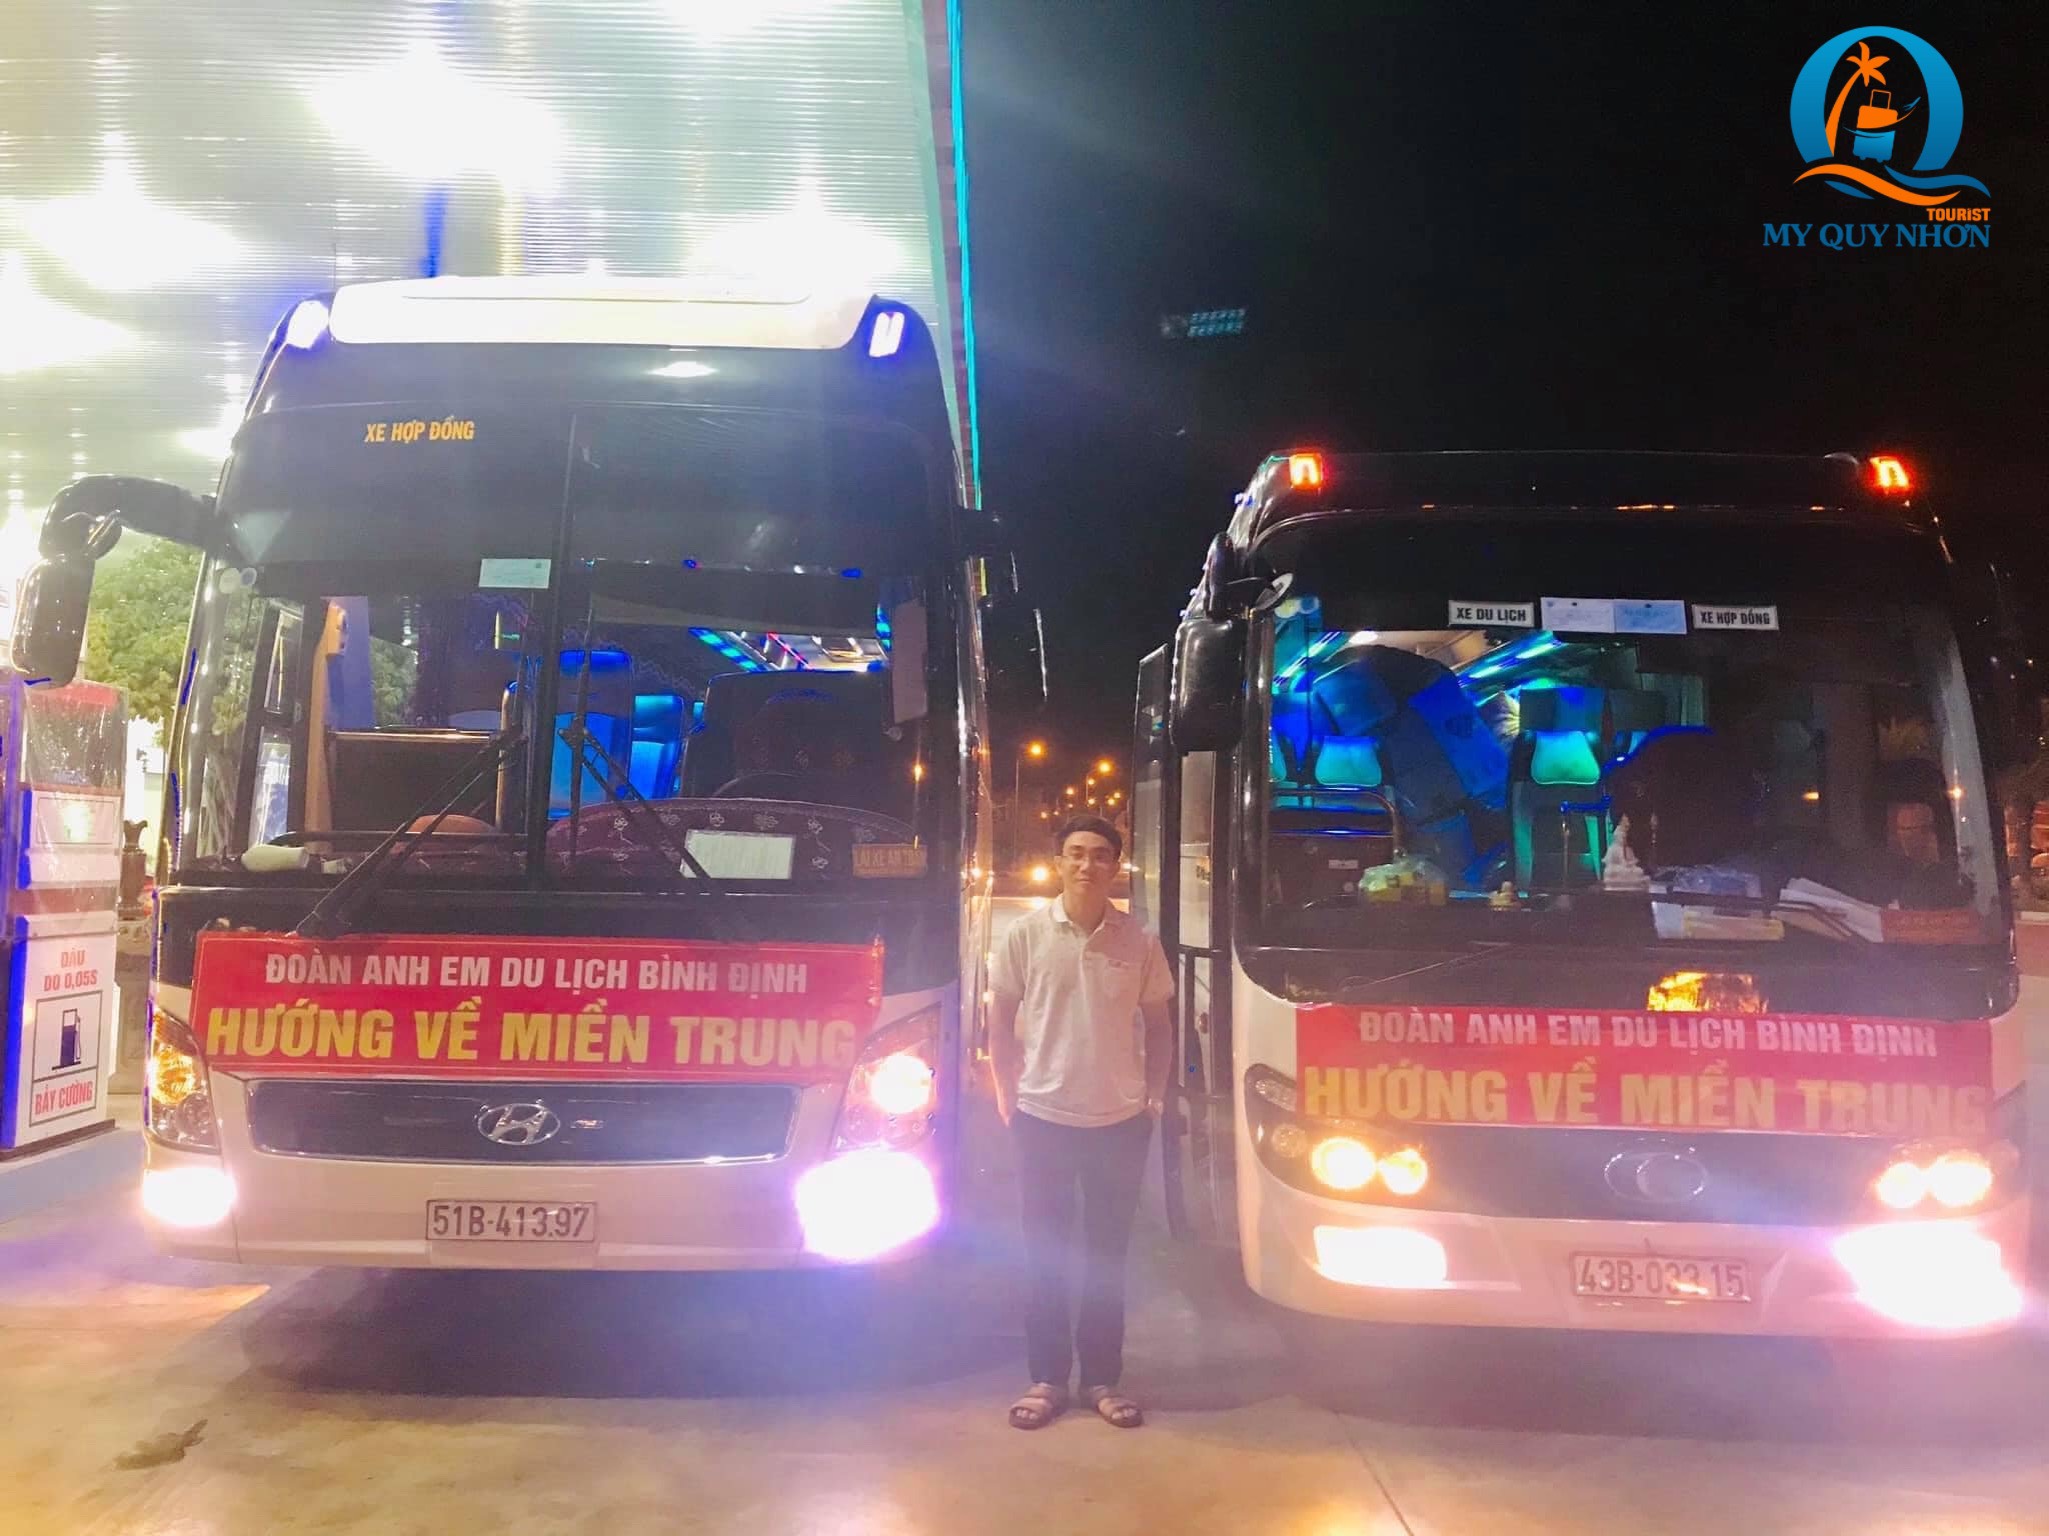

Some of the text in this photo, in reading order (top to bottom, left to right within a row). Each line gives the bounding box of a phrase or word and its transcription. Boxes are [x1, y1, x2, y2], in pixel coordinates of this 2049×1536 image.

[364, 423, 386, 443] XE
[391, 419, 425, 444] HỢP
[1457, 607, 1527, 623] XE DU LỊCH
[1701, 611, 1714, 624] XE
[1717, 610, 1738, 626] HỢP
[44, 974, 61, 991] DO
[265, 948, 807, 999] ĐOÀN ANH EM DU LỊCH BÌNH ĐỊNH
[206, 996, 857, 1068] HƯỚNG VỀ MIỀN TRUNG
[1360, 1007, 1937, 1063] ĐOÀN ANH EM DU LỊCH BÌNH ĐỊNH
[1304, 1056, 1987, 1137] HƯỚNG VỀ MIỀN TRUNG
[432, 1205, 589, 1238] 51B-413.97
[1577, 1257, 1744, 1298] 43B-03315
